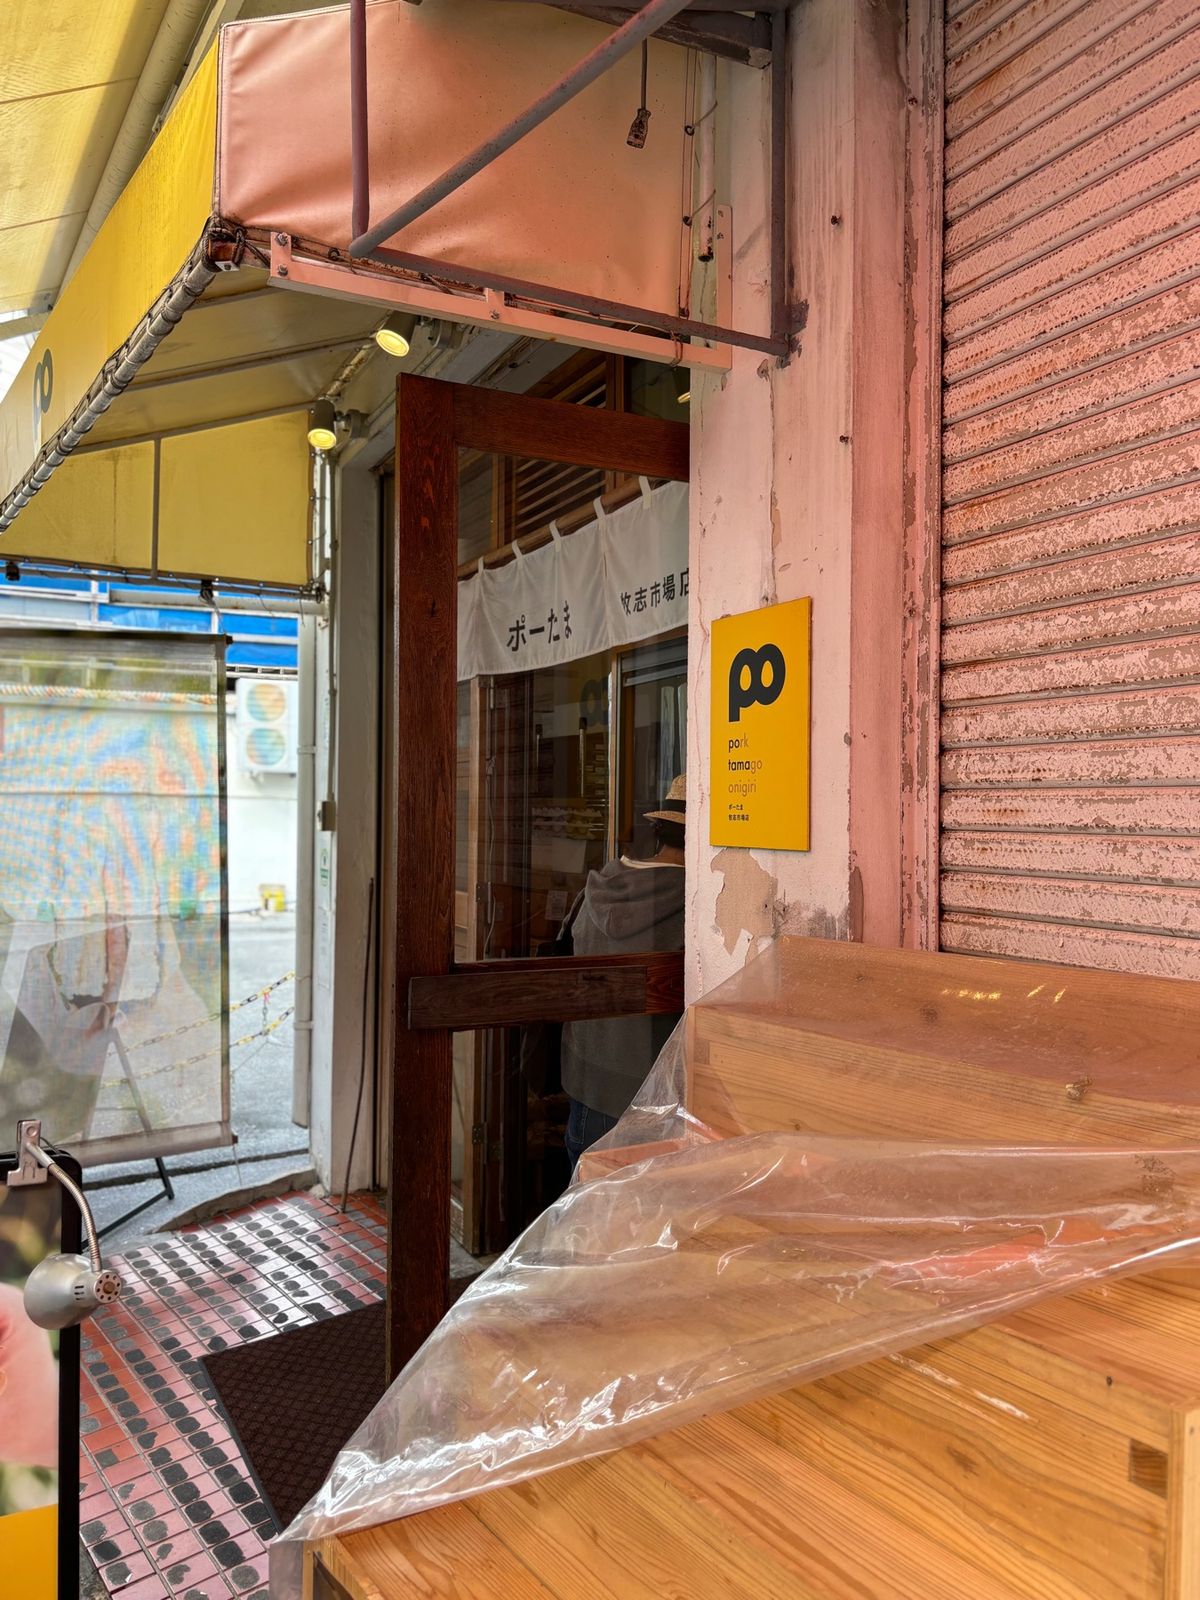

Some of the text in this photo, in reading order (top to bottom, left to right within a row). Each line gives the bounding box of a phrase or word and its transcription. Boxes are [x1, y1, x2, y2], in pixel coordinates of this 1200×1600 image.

[506, 599, 573, 652] ポーたま
[729, 643, 786, 723] po
[728, 732, 750, 753] pork
[728, 759, 763, 774] tamago
[728, 778, 758, 797] onigiri
